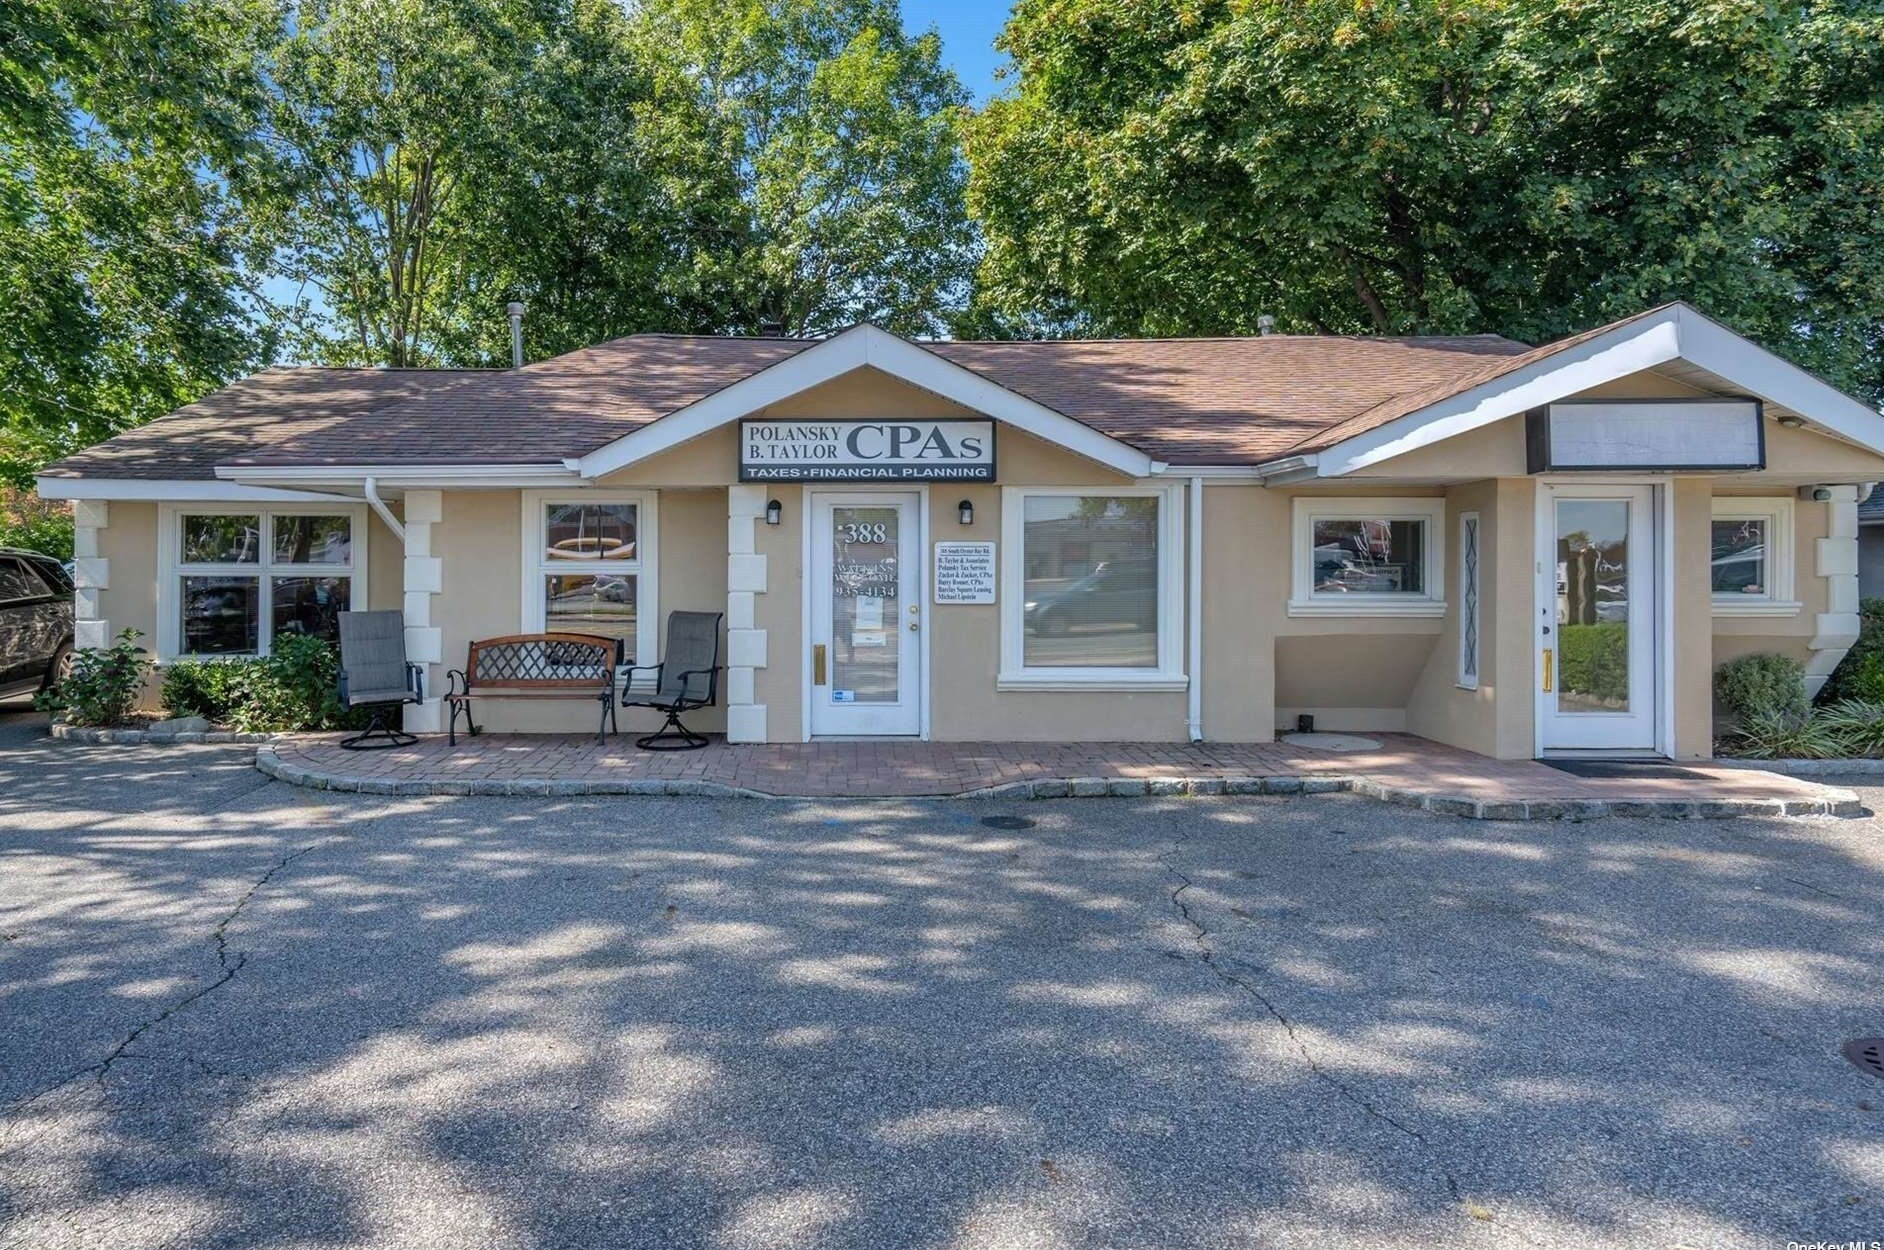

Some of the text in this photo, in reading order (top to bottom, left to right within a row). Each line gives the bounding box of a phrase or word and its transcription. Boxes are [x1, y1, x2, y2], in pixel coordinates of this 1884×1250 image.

[750, 426, 842, 441] POLANSKY
[846, 424, 982, 460] CPAs
[750, 444, 838, 459] B. TAYLOR
[748, 468, 988, 478] TAXES FINANCIAL PLANNING
[844, 523, 887, 544] 388
